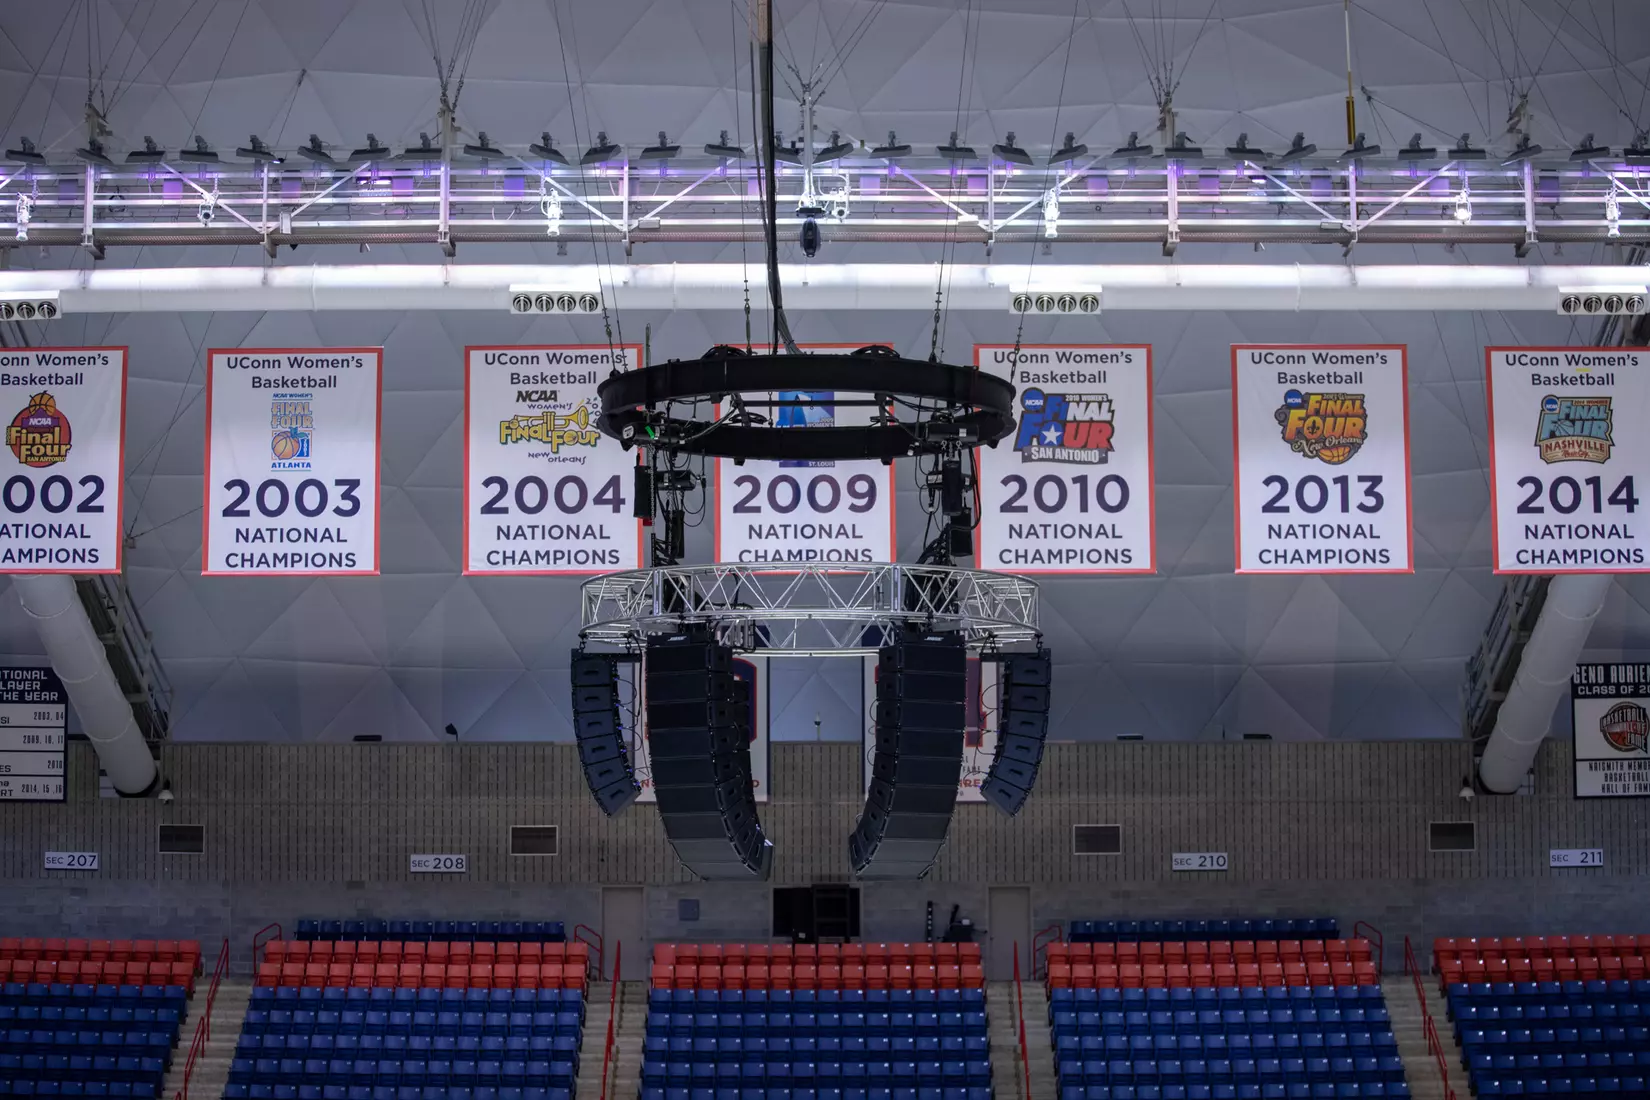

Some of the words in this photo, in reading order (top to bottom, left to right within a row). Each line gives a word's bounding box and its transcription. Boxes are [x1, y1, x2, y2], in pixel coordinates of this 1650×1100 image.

[36, 354, 109, 366] Women's
[227, 356, 281, 369] UConn
[287, 356, 363, 368] Women's
[484, 353, 540, 365] UConn
[994, 352, 1049, 364] UConn
[1056, 351, 1132, 364] Women's
[1251, 352, 1306, 364] UConn
[1312, 352, 1388, 364] Women's
[1506, 354, 1559, 366] UConn
[1564, 354, 1638, 366] Women's
[1, 373, 83, 386] Basketball
[252, 376, 337, 388] Basketball
[510, 372, 597, 384] Basketball
[1020, 370, 1106, 384] Basketball
[1278, 372, 1363, 384] Basketball
[1532, 373, 1614, 386] Basketball
[516, 390, 558, 402] NCAA
[271, 402, 312, 416] FINAL
[1045, 396, 1112, 421] FINAL
[1308, 394, 1364, 415] FINAL
[1560, 400, 1608, 420] FINAL
[29, 418, 52, 426] NCAA
[1286, 410, 1364, 440] FOUR
[10, 426, 60, 444] Final
[20, 444, 71, 462] Four
[1544, 440, 1605, 453] NASHVILLE
[1031, 447, 1053, 460] SAN
[1055, 448, 1099, 463] ANTONIO
[222, 478, 361, 518] 2003
[480, 475, 626, 514] 2004
[733, 474, 877, 514] 2009
[1000, 474, 1130, 514] 2010
[1262, 475, 1384, 514] 2013
[1516, 476, 1639, 514] 2014
[236, 528, 348, 543] NATIONAL
[496, 524, 610, 540] NATIONAL
[748, 524, 863, 540] NATIONAL
[1009, 524, 1123, 539] NATIONAL
[1268, 524, 1380, 539] NATIONAL
[1525, 524, 1634, 540] NATIONAL
[225, 552, 357, 568] CHAMPIONS
[486, 550, 620, 566] CHAMPIONS
[738, 549, 872, 562] CHAMPIONS
[999, 548, 1132, 564] CHAMPIONS
[1258, 548, 1390, 564] CHAMPIONS
[1516, 548, 1644, 564] CHAMPIONS
[0, 670, 48, 680] TIONAL
[25, 692, 58, 701] YEAR
[1578, 686, 1616, 695] CLASS
[1620, 685, 1634, 694] OF
[1589, 762, 1624, 772] NAISMITH
[1604, 772, 1648, 782] BASKETBALL
[1602, 784, 1618, 793] HALL
[1623, 784, 1630, 793] OF
[67, 855, 96, 866] 207
[433, 858, 464, 869] 208
[1198, 856, 1226, 867] 210
[1580, 852, 1602, 863] 211
